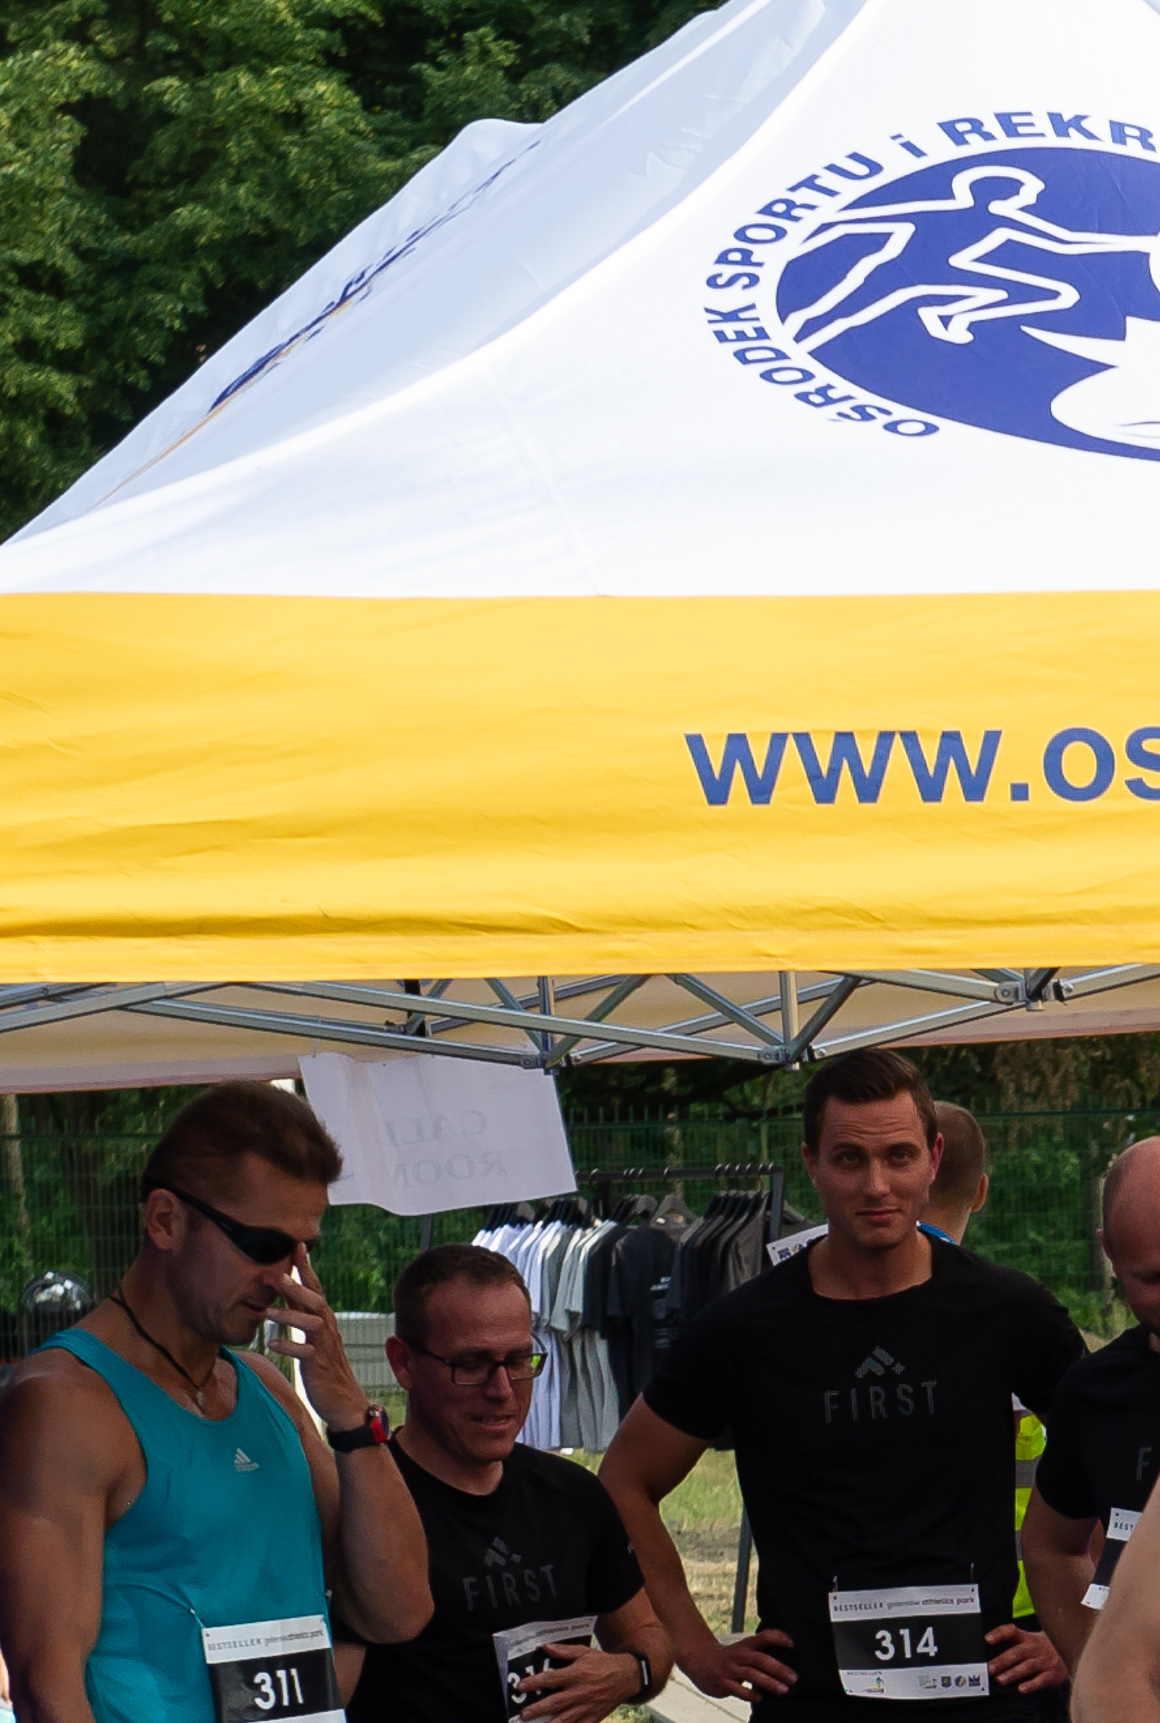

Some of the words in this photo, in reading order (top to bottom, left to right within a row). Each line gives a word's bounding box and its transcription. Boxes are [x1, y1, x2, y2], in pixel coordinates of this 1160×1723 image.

[890, 133, 928, 158] i
[705, 151, 885, 291] SPORTU
[703, 303, 940, 437] OŚRODEK
[824, 1380, 937, 1424] FIRST
[462, 1565, 555, 1612] FIRST
[956, 1595, 975, 1606] park
[874, 1626, 938, 1661] 314
[253, 1668, 304, 1710] 311
